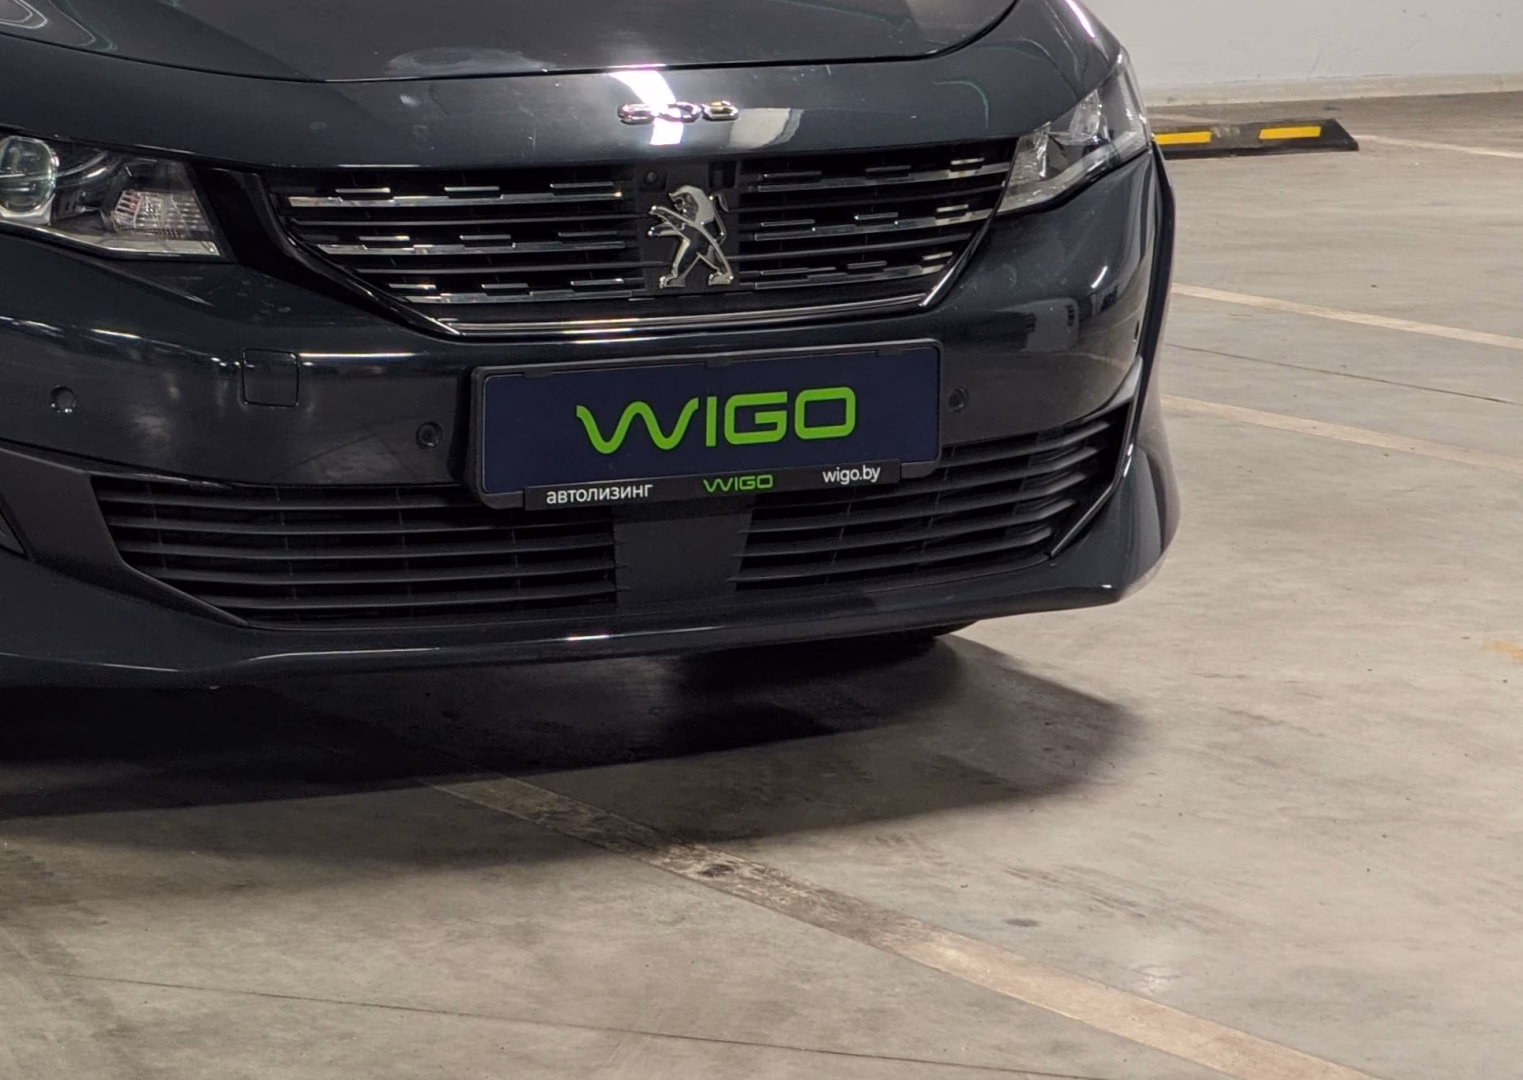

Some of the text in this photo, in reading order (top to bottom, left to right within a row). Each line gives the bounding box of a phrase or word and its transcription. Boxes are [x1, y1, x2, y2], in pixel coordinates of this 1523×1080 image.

[577, 386, 856, 454] WIGO
[703, 474, 774, 493] WIGO
[822, 466, 881, 486] wigo.by
[546, 484, 654, 505] автолизинг
